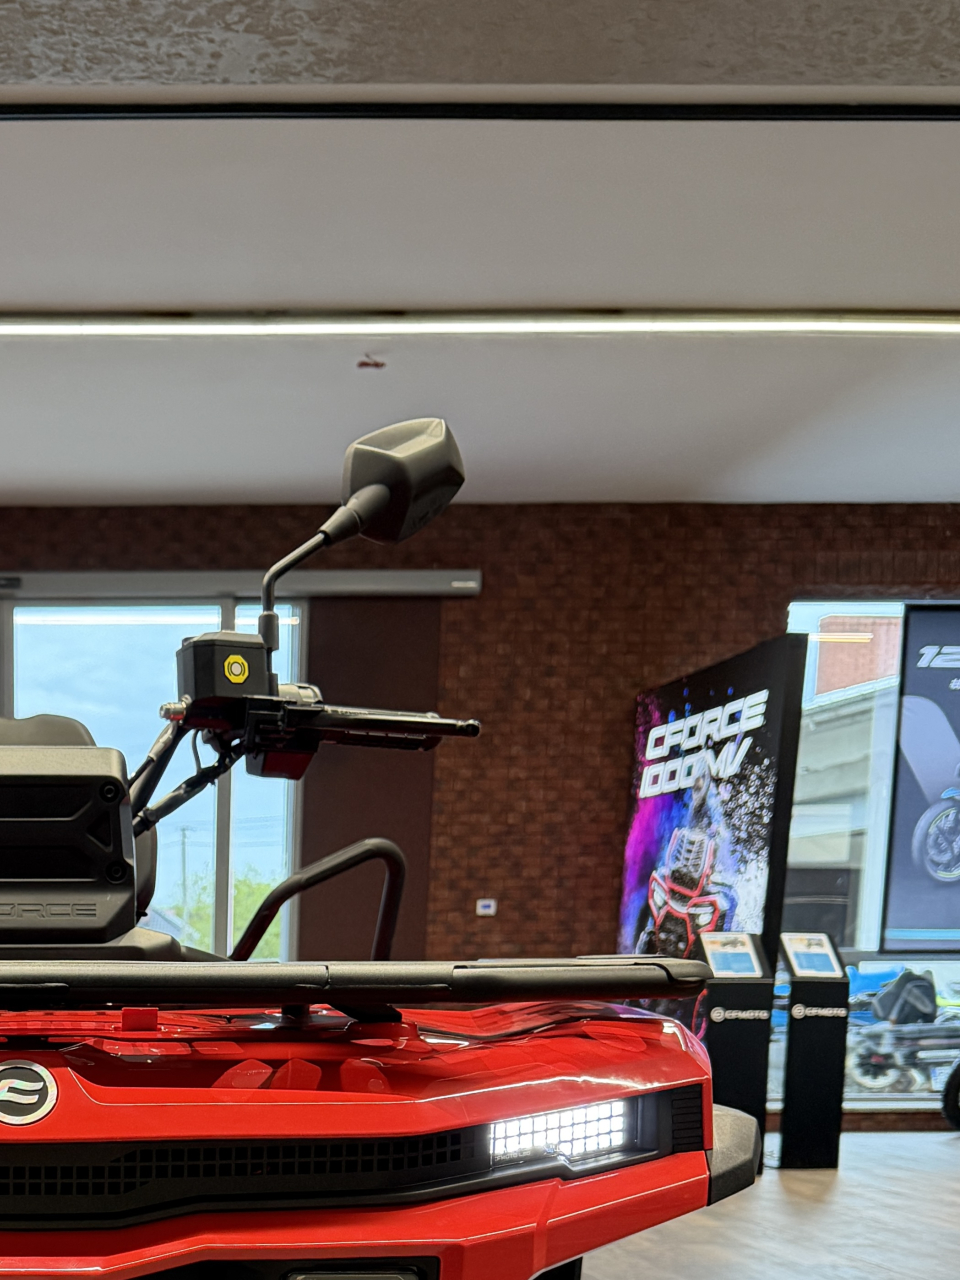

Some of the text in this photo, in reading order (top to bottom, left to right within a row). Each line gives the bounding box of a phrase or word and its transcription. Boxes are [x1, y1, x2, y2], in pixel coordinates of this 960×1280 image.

[645, 689, 769, 760] CFORCE
[724, 1009, 770, 1020] CFMOTO
[804, 1006, 847, 1018] CFMOTO
